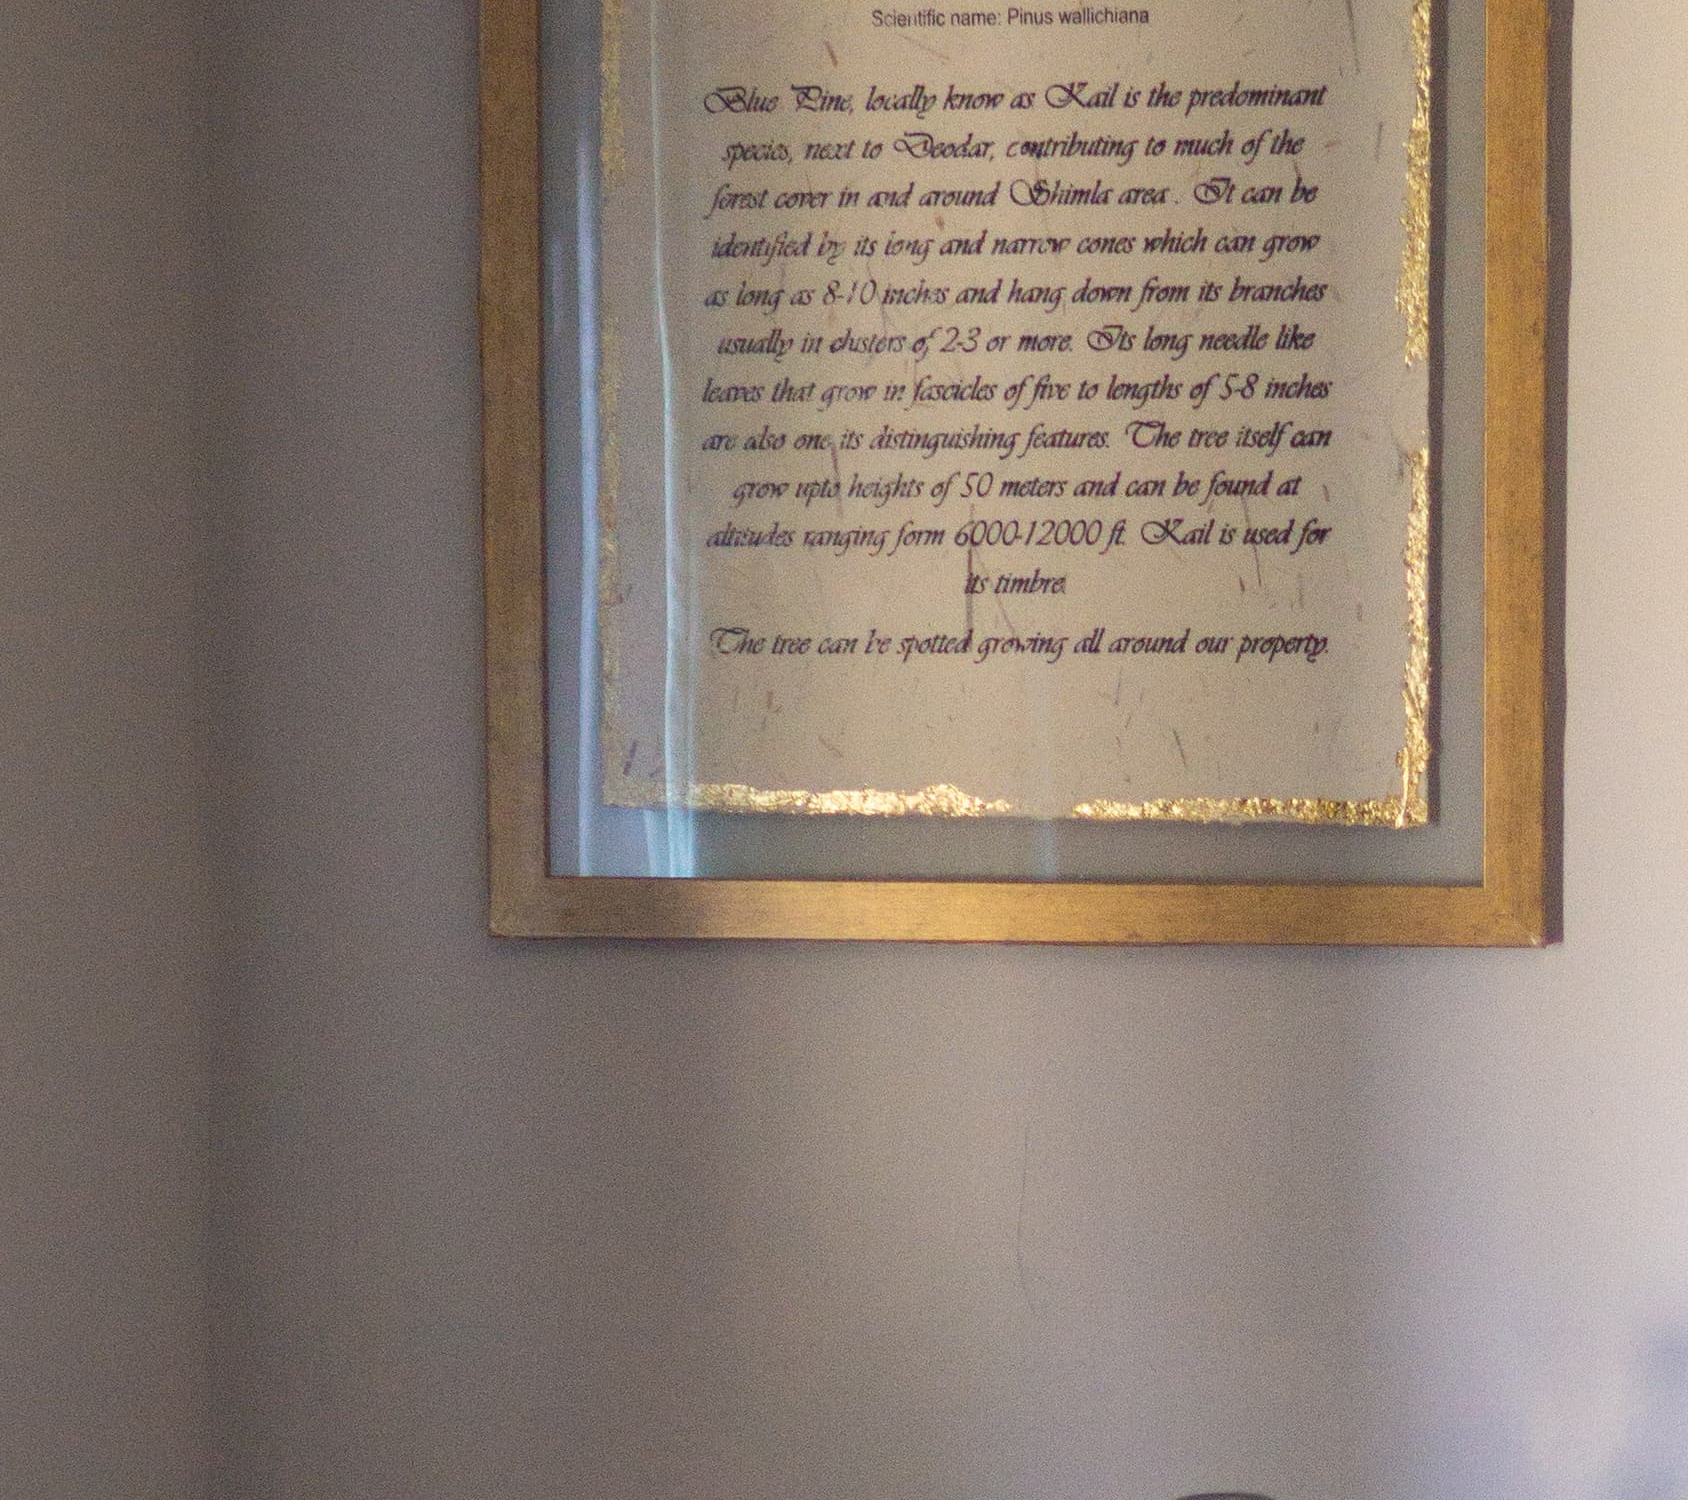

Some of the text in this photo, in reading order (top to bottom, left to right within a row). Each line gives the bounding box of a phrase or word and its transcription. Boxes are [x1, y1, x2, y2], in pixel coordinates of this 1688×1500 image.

[872, 7, 1149, 27] Scientific name: Pinus wallichiana
[703, 79, 1329, 119] Blue Pine, locally know as Kail is the predominant
[722, 128, 1305, 171] species, next to Deodar, contributing to much of the
[703, 183, 769, 220] forest
[774, 189, 832, 210] cover
[838, 185, 860, 209] in
[866, 181, 915, 210] and
[919, 180, 1001, 208] around
[1010, 178, 1114, 206] Shimla
[1194, 177, 1236, 205] It
[1241, 184, 1283, 205] can
[1290, 177, 1318, 204] be
[711, 227, 1321, 266] identified by its long and narrow cones which can grow
[703, 275, 1329, 315] as long as 8-10 inches and hang down from its branches
[717, 323, 1316, 365] usually in clusters of 2-3 or more. Its long needle like
[702, 372, 1333, 412] leaves that grow in fascicles of five to lengths of 5-8 inches
[702, 420, 1333, 460] are also one its distinguishing features. The tree itself can
[730, 469, 1302, 508] grow upto heights of 50 meters and can be found at
[706, 521, 794, 547] altitudes
[803, 525, 889, 556] ranging
[887, 520, 946, 556] form
[954, 518, 1102, 546] 6000-12000
[1140, 518, 1215, 545] Kail
[1219, 524, 1237, 546] is
[1243, 518, 1295, 545] used
[1289, 517, 1332, 555] for
[964, 573, 985, 594] its
[710, 627, 1329, 664] The tree can be spotted growing all around our property.
